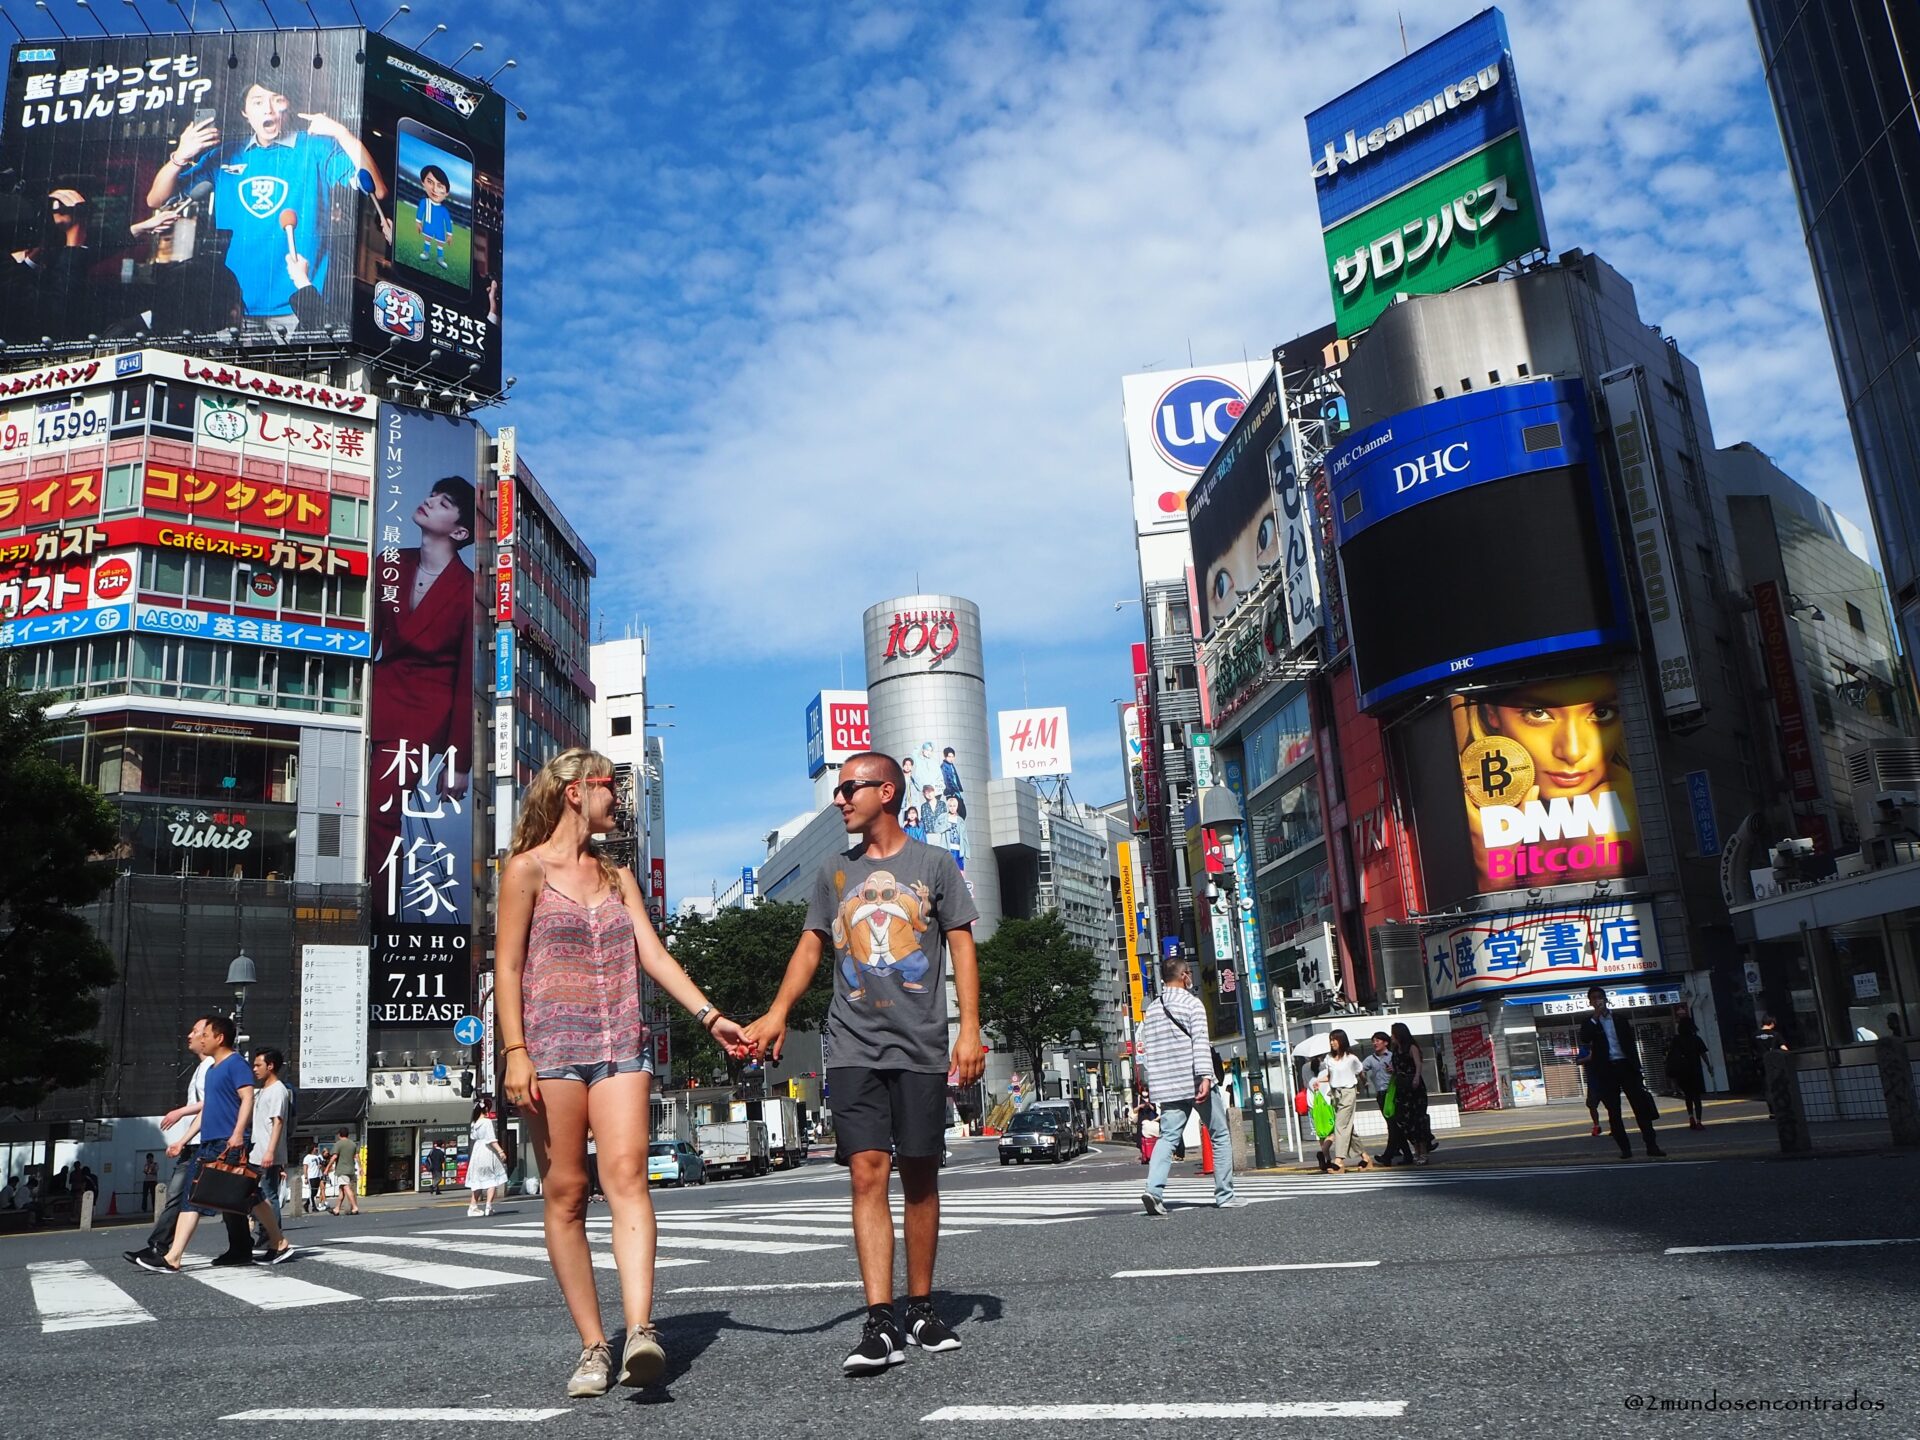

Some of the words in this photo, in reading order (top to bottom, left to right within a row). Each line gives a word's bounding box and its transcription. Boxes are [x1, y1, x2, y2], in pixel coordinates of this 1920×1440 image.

[17, 49, 55, 62] SEGA
[24, 54, 199, 101] 監督やっても
[21, 78, 212, 128] いいんすか!?
[1309, 63, 1500, 178] Hisamitsu
[1333, 175, 1518, 295] サロンパス
[431, 303, 487, 335] スマホで
[431, 318, 485, 351] サカつく
[118, 355, 140, 372] 寿司
[184, 359, 367, 412] しゃぶしゃぶバイキング
[259, 411, 364, 458] しゃぶ葉
[1218, 446, 1236, 481] BEST
[1251, 413, 1262, 433] on
[1261, 390, 1278, 421] sale
[1332, 452, 1351, 476] DHC
[1351, 430, 1393, 462] Channel
[1393, 441, 1471, 494] DHC
[146, 469, 322, 522] コンタクト
[34, 526, 107, 562] ガスト
[158, 528, 206, 548] Café
[207, 537, 265, 559] レストラン
[269, 541, 349, 576] ガスト
[1273, 438, 1316, 628] もんじゃ
[98, 575, 129, 590] ガスト
[254, 582, 275, 592] ガスト
[499, 582, 510, 614] ガスト
[98, 612, 118, 627] 6F
[146, 611, 199, 632] AEON
[499, 634, 510, 691] 英会話イーオン
[882, 621, 959, 663] 109
[1450, 657, 1474, 672] DHC
[499, 711, 509, 770] 渋谷駅前ビル
[1009, 716, 1059, 752] H&M
[167, 823, 253, 851] Ushi8
[379, 739, 462, 917] 想像
[1479, 790, 1631, 849] DMM
[653, 868, 664, 890] 免税
[1487, 836, 1634, 880] Bitcoin
[1126, 895, 1136, 943] Matsumoto
[371, 935, 466, 950] JUNHO
[382, 953, 416, 963] (from
[422, 953, 454, 963] 2PM)
[1434, 917, 1645, 986] 大盛堂書店
[387, 973, 446, 998] 7.11
[1603, 964, 1625, 972] BOOKS
[1627, 960, 1658, 970] TAISEIDO
[370, 1004, 465, 1021] RELEASE
